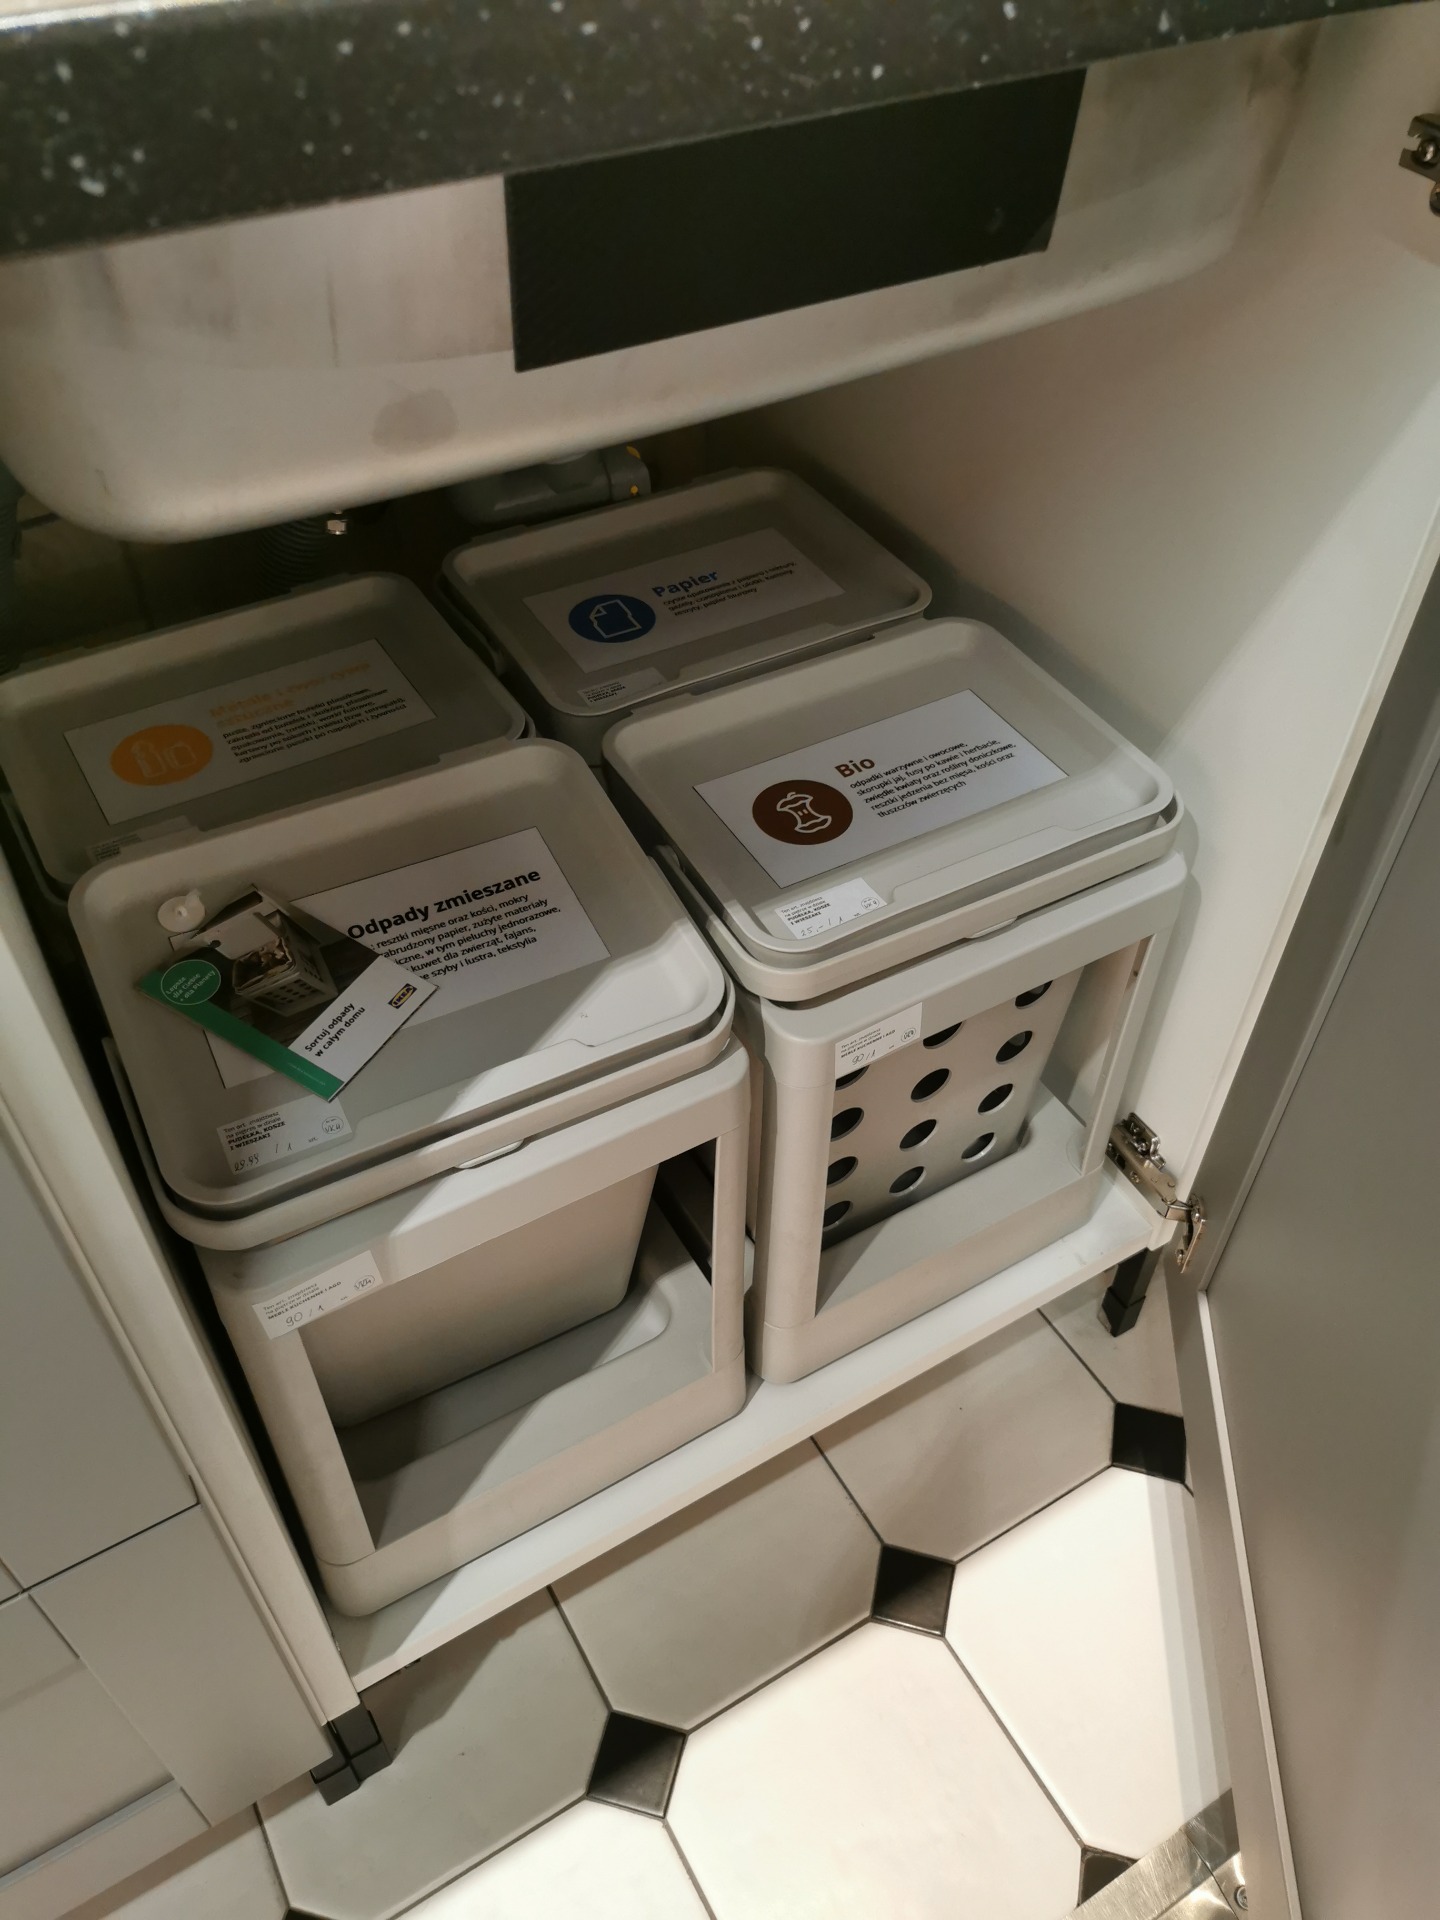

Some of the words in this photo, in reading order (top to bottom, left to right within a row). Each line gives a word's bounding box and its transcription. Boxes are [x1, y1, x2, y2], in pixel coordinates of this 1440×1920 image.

[652, 570, 718, 597] Papier
[834, 759, 875, 778] Bio
[850, 773, 883, 789] odpadki
[883, 759, 924, 776] warzywne
[857, 779, 893, 796] skorupki
[892, 774, 906, 784] jaj,
[905, 768, 924, 777] fusy
[924, 763, 936, 771] po
[934, 755, 960, 766] kawie
[962, 740, 1000, 755] herbacie,
[864, 789, 895, 803] zwiędłe
[894, 778, 922, 791] kwiaty
[922, 771, 941, 781] oraz
[941, 761, 968, 774] rośliny
[968, 744, 1016, 763] doniczkowe,
[871, 797, 899, 810] resztki
[897, 784, 933, 801] jedzenia
[932, 778, 949, 787] bez
[948, 769, 976, 780] mięsa,
[974, 759, 997, 770] kości
[996, 753, 1014, 762] oraz
[877, 800, 918, 818] tłuszczów
[918, 781, 966, 802] zwierzęcych
[347, 904, 429, 940] Odpady
[433, 870, 541, 914] zmieszane
[376, 932, 409, 948] resztki
[410, 922, 446, 938] mięsne
[447, 914, 470, 925] oraz
[469, 905, 498, 918] kości,
[498, 894, 528, 909] mokry
[437, 925, 471, 941] papier,
[472, 914, 503, 929] zużyte
[504, 899, 548, 918] materiały
[410, 957, 442, 972] kuwet
[443, 952, 459, 961] dla
[460, 937, 503, 956] zwierząt,
[504, 927, 536, 940] fajans,
[425, 948, 434, 956] w
[435, 942, 456, 953] tym
[457, 927, 497, 946] pieluchy
[497, 907, 561, 932] jednorazowe,
[431, 963, 458, 977] szyby
[464, 952, 496, 965] lustra,
[497, 937, 537, 954] tekstylia
[173, 988, 183, 999] dla
[184, 988, 194, 999] dla
[305, 1028, 330, 1052] Sortuj
[328, 1003, 355, 1029] odpady
[315, 1049, 323, 1057] w
[323, 1028, 345, 1049] całym
[344, 1007, 365, 1028] domu
[235, 1133, 270, 1148] WIESZAKI
[263, 1121, 285, 1132] KOSZE
